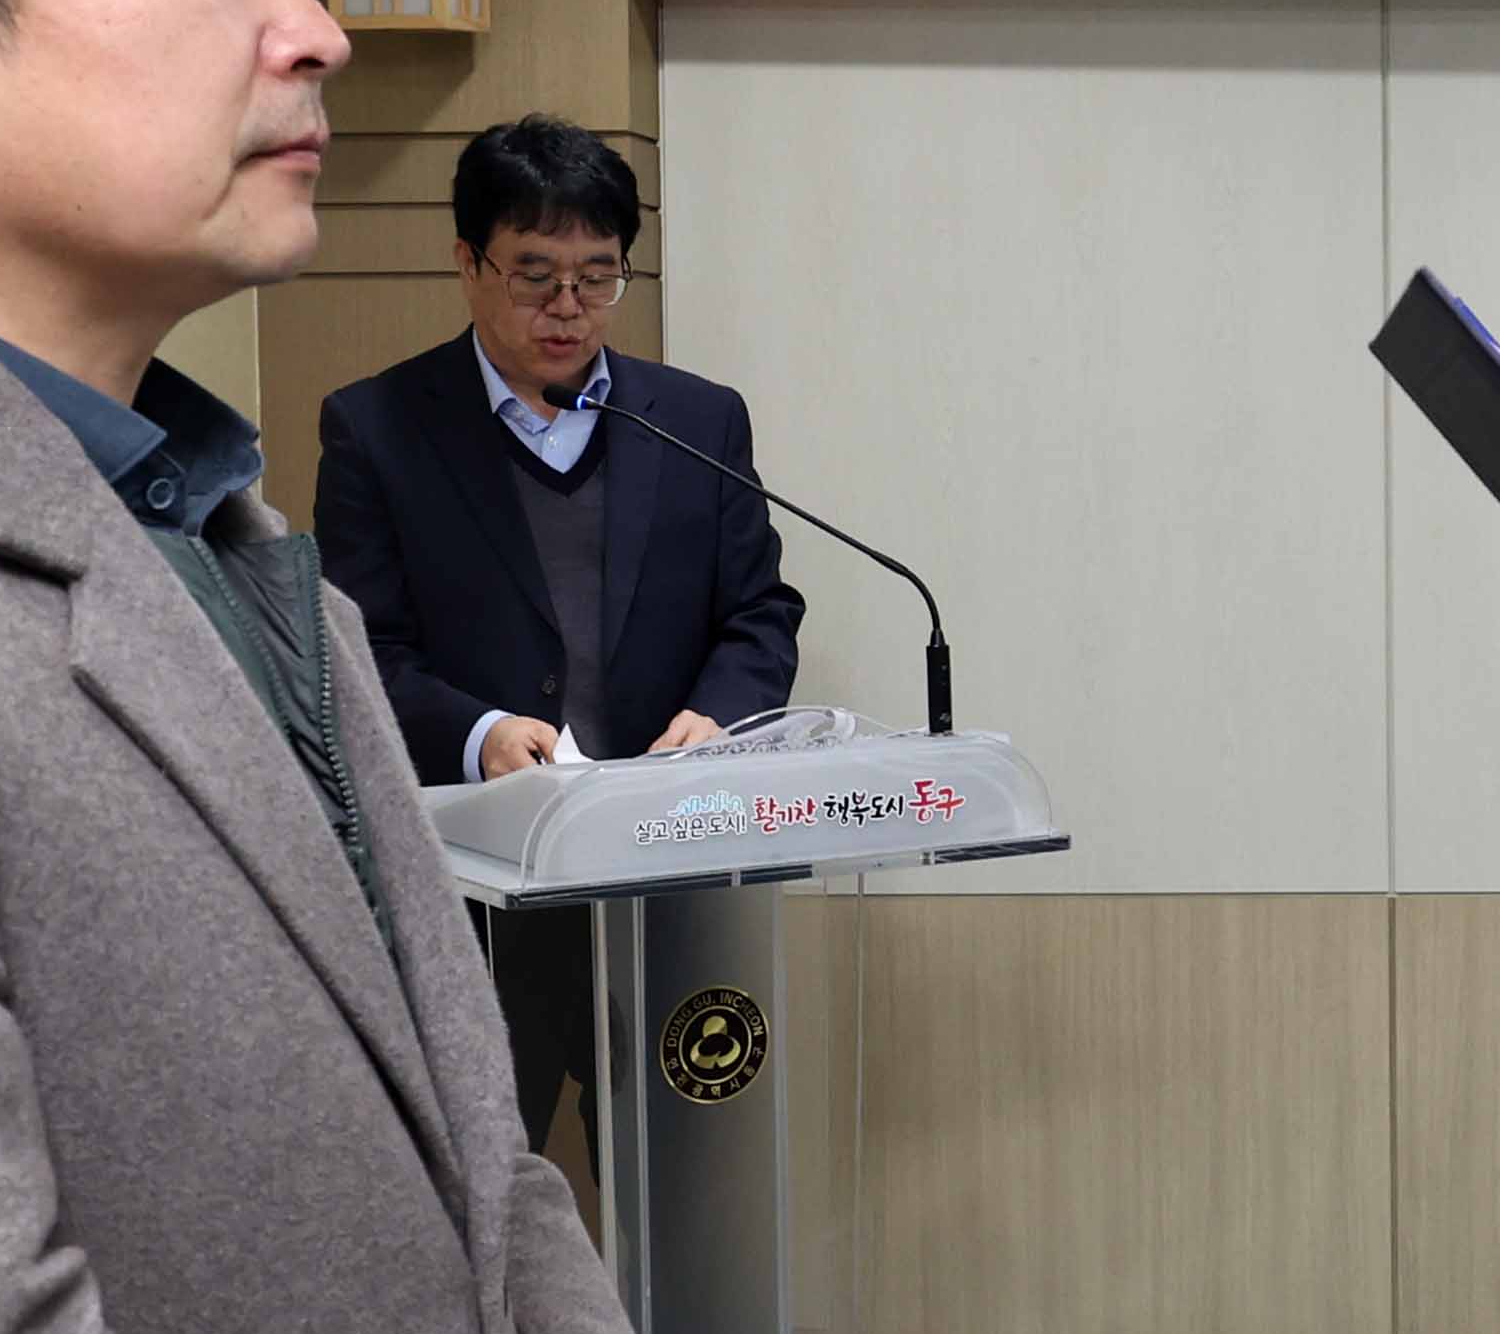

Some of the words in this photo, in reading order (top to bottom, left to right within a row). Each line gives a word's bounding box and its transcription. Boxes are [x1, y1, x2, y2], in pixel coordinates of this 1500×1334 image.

[635, 822, 668, 844] 살고
[673, 818, 705, 841] 싶은
[709, 814, 747, 836] 도시!
[754, 797, 817, 833] 활기찬
[823, 791, 905, 827] 행복도시
[909, 780, 965, 822] 동구
